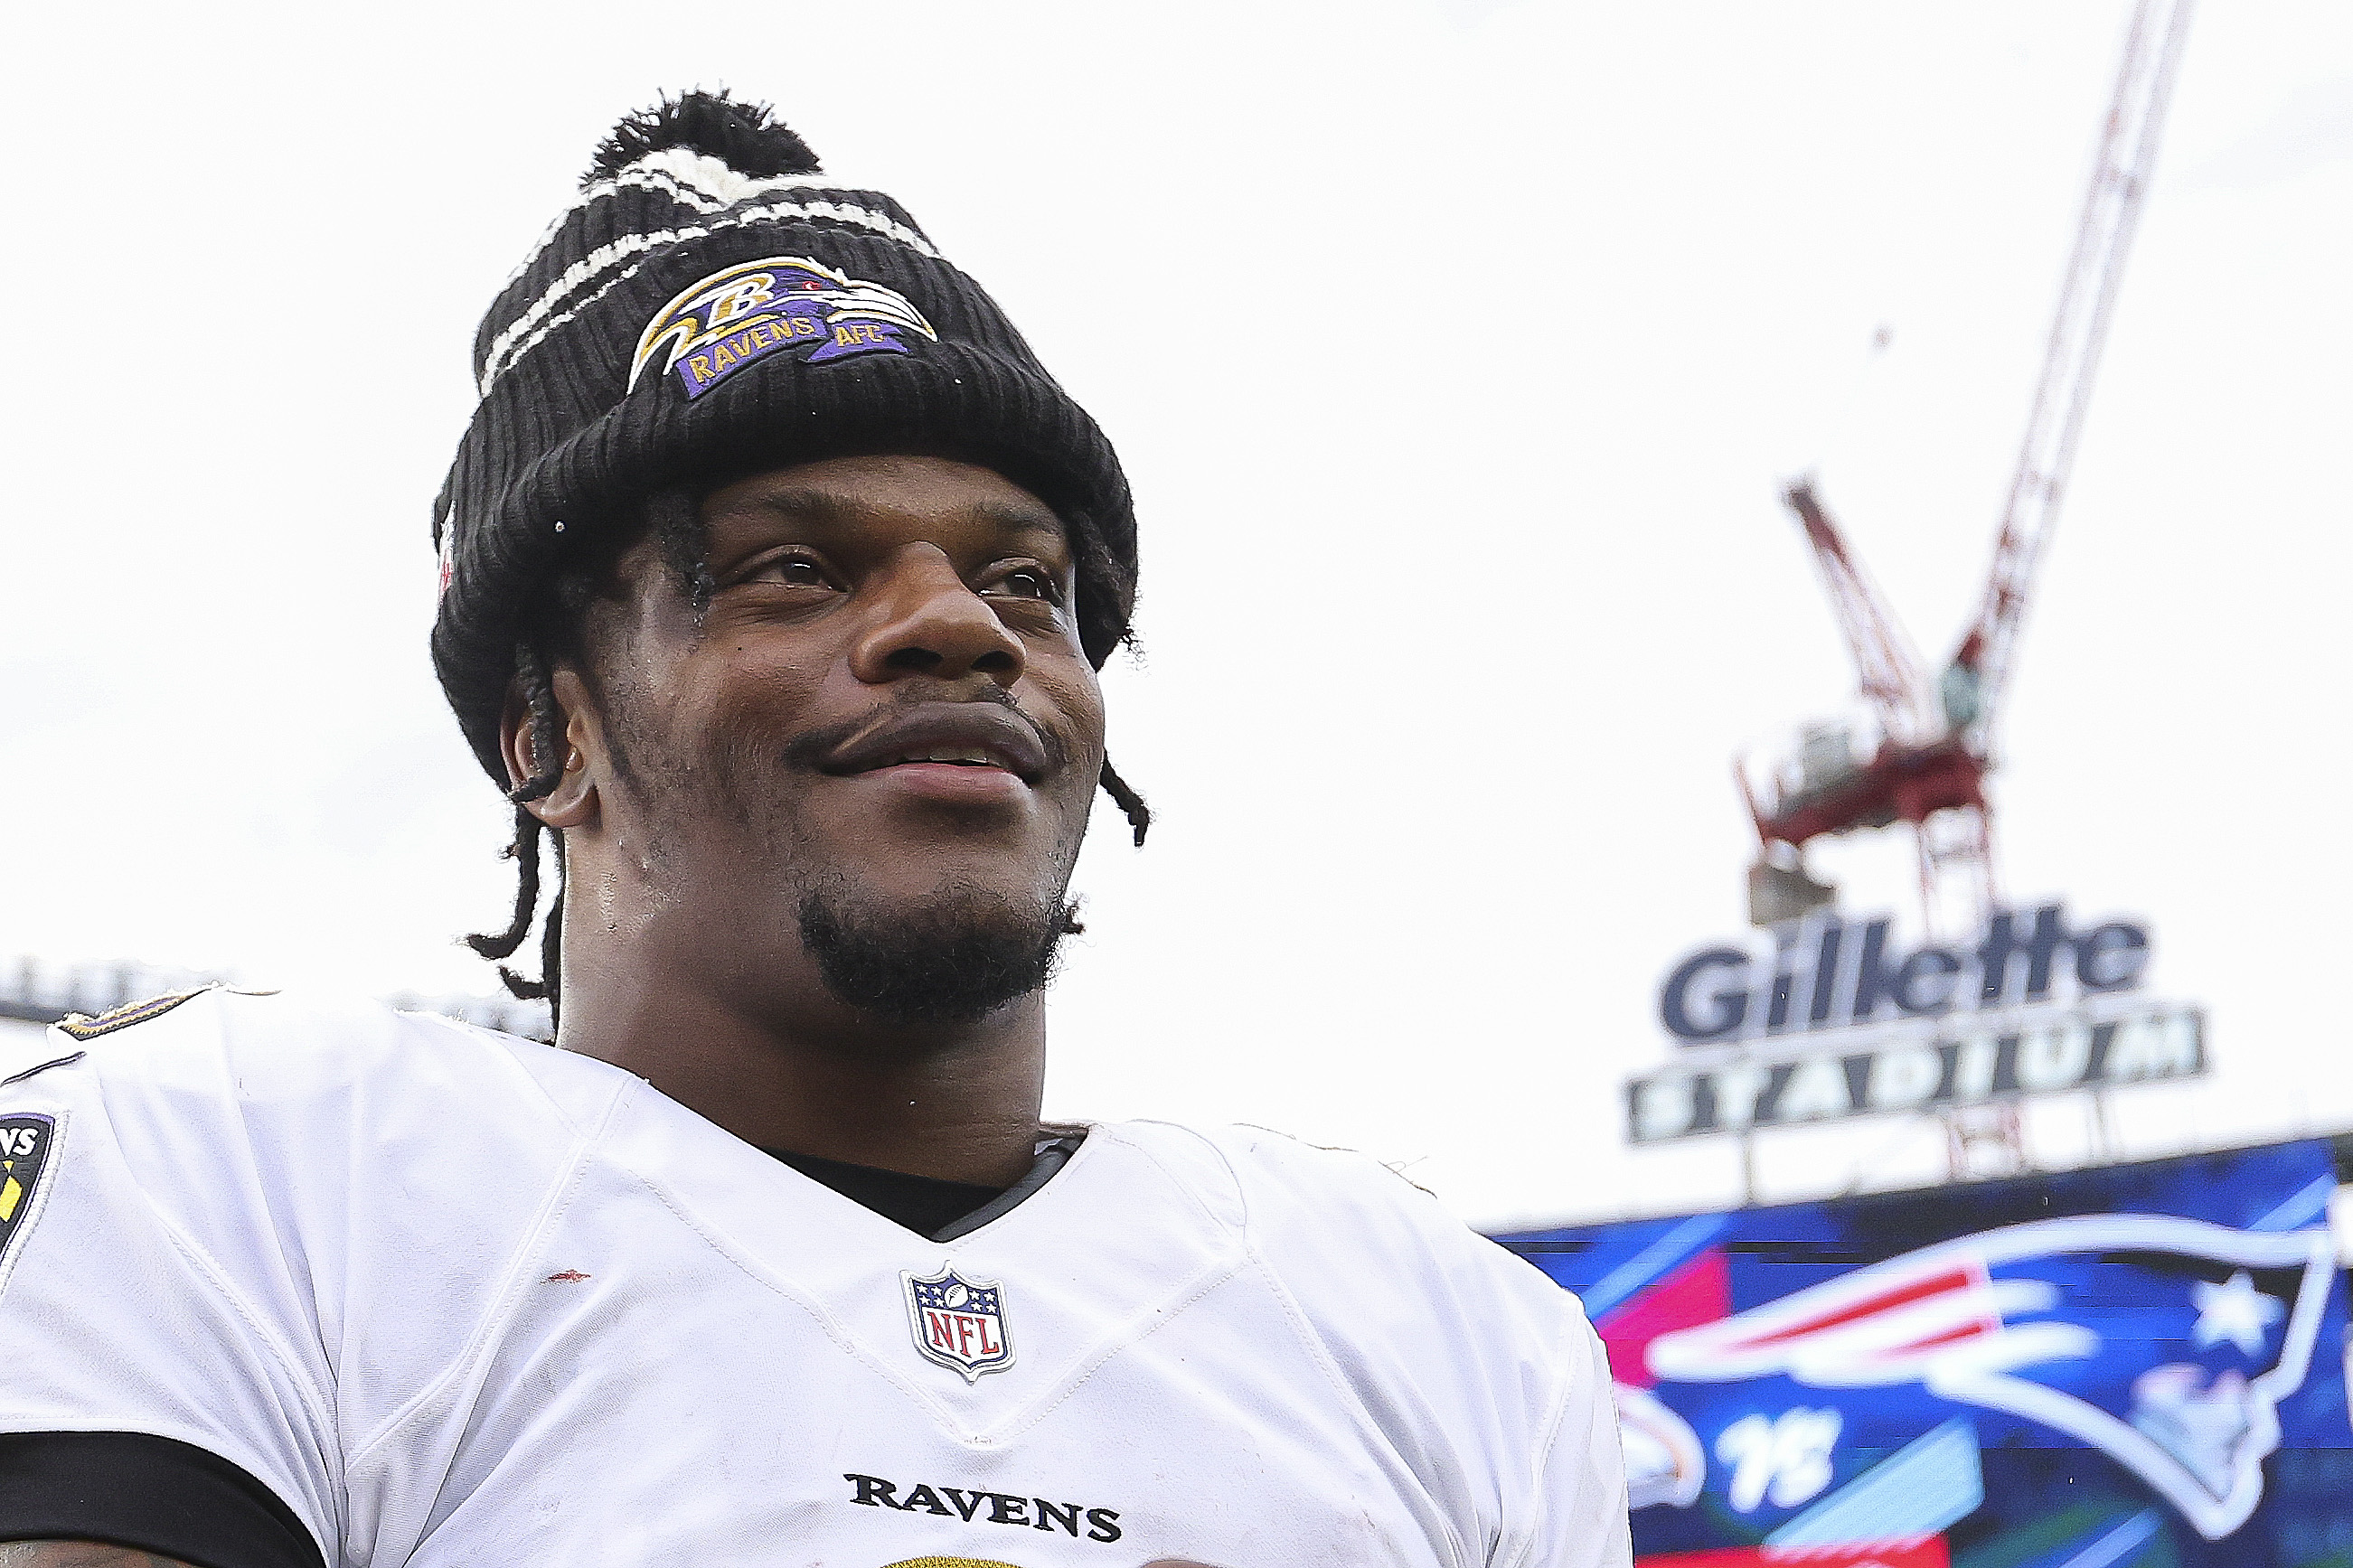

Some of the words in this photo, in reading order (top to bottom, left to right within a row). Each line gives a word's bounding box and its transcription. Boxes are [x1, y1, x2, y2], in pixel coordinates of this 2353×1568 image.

[688, 317, 816, 384] RAVENS
[834, 324, 886, 347] AFC
[1660, 906, 2148, 1038] Gillette
[1632, 1009, 2206, 1139] STADIUM
[927, 1311, 1000, 1357] NFL
[843, 1473, 1122, 1543] RAVENS
